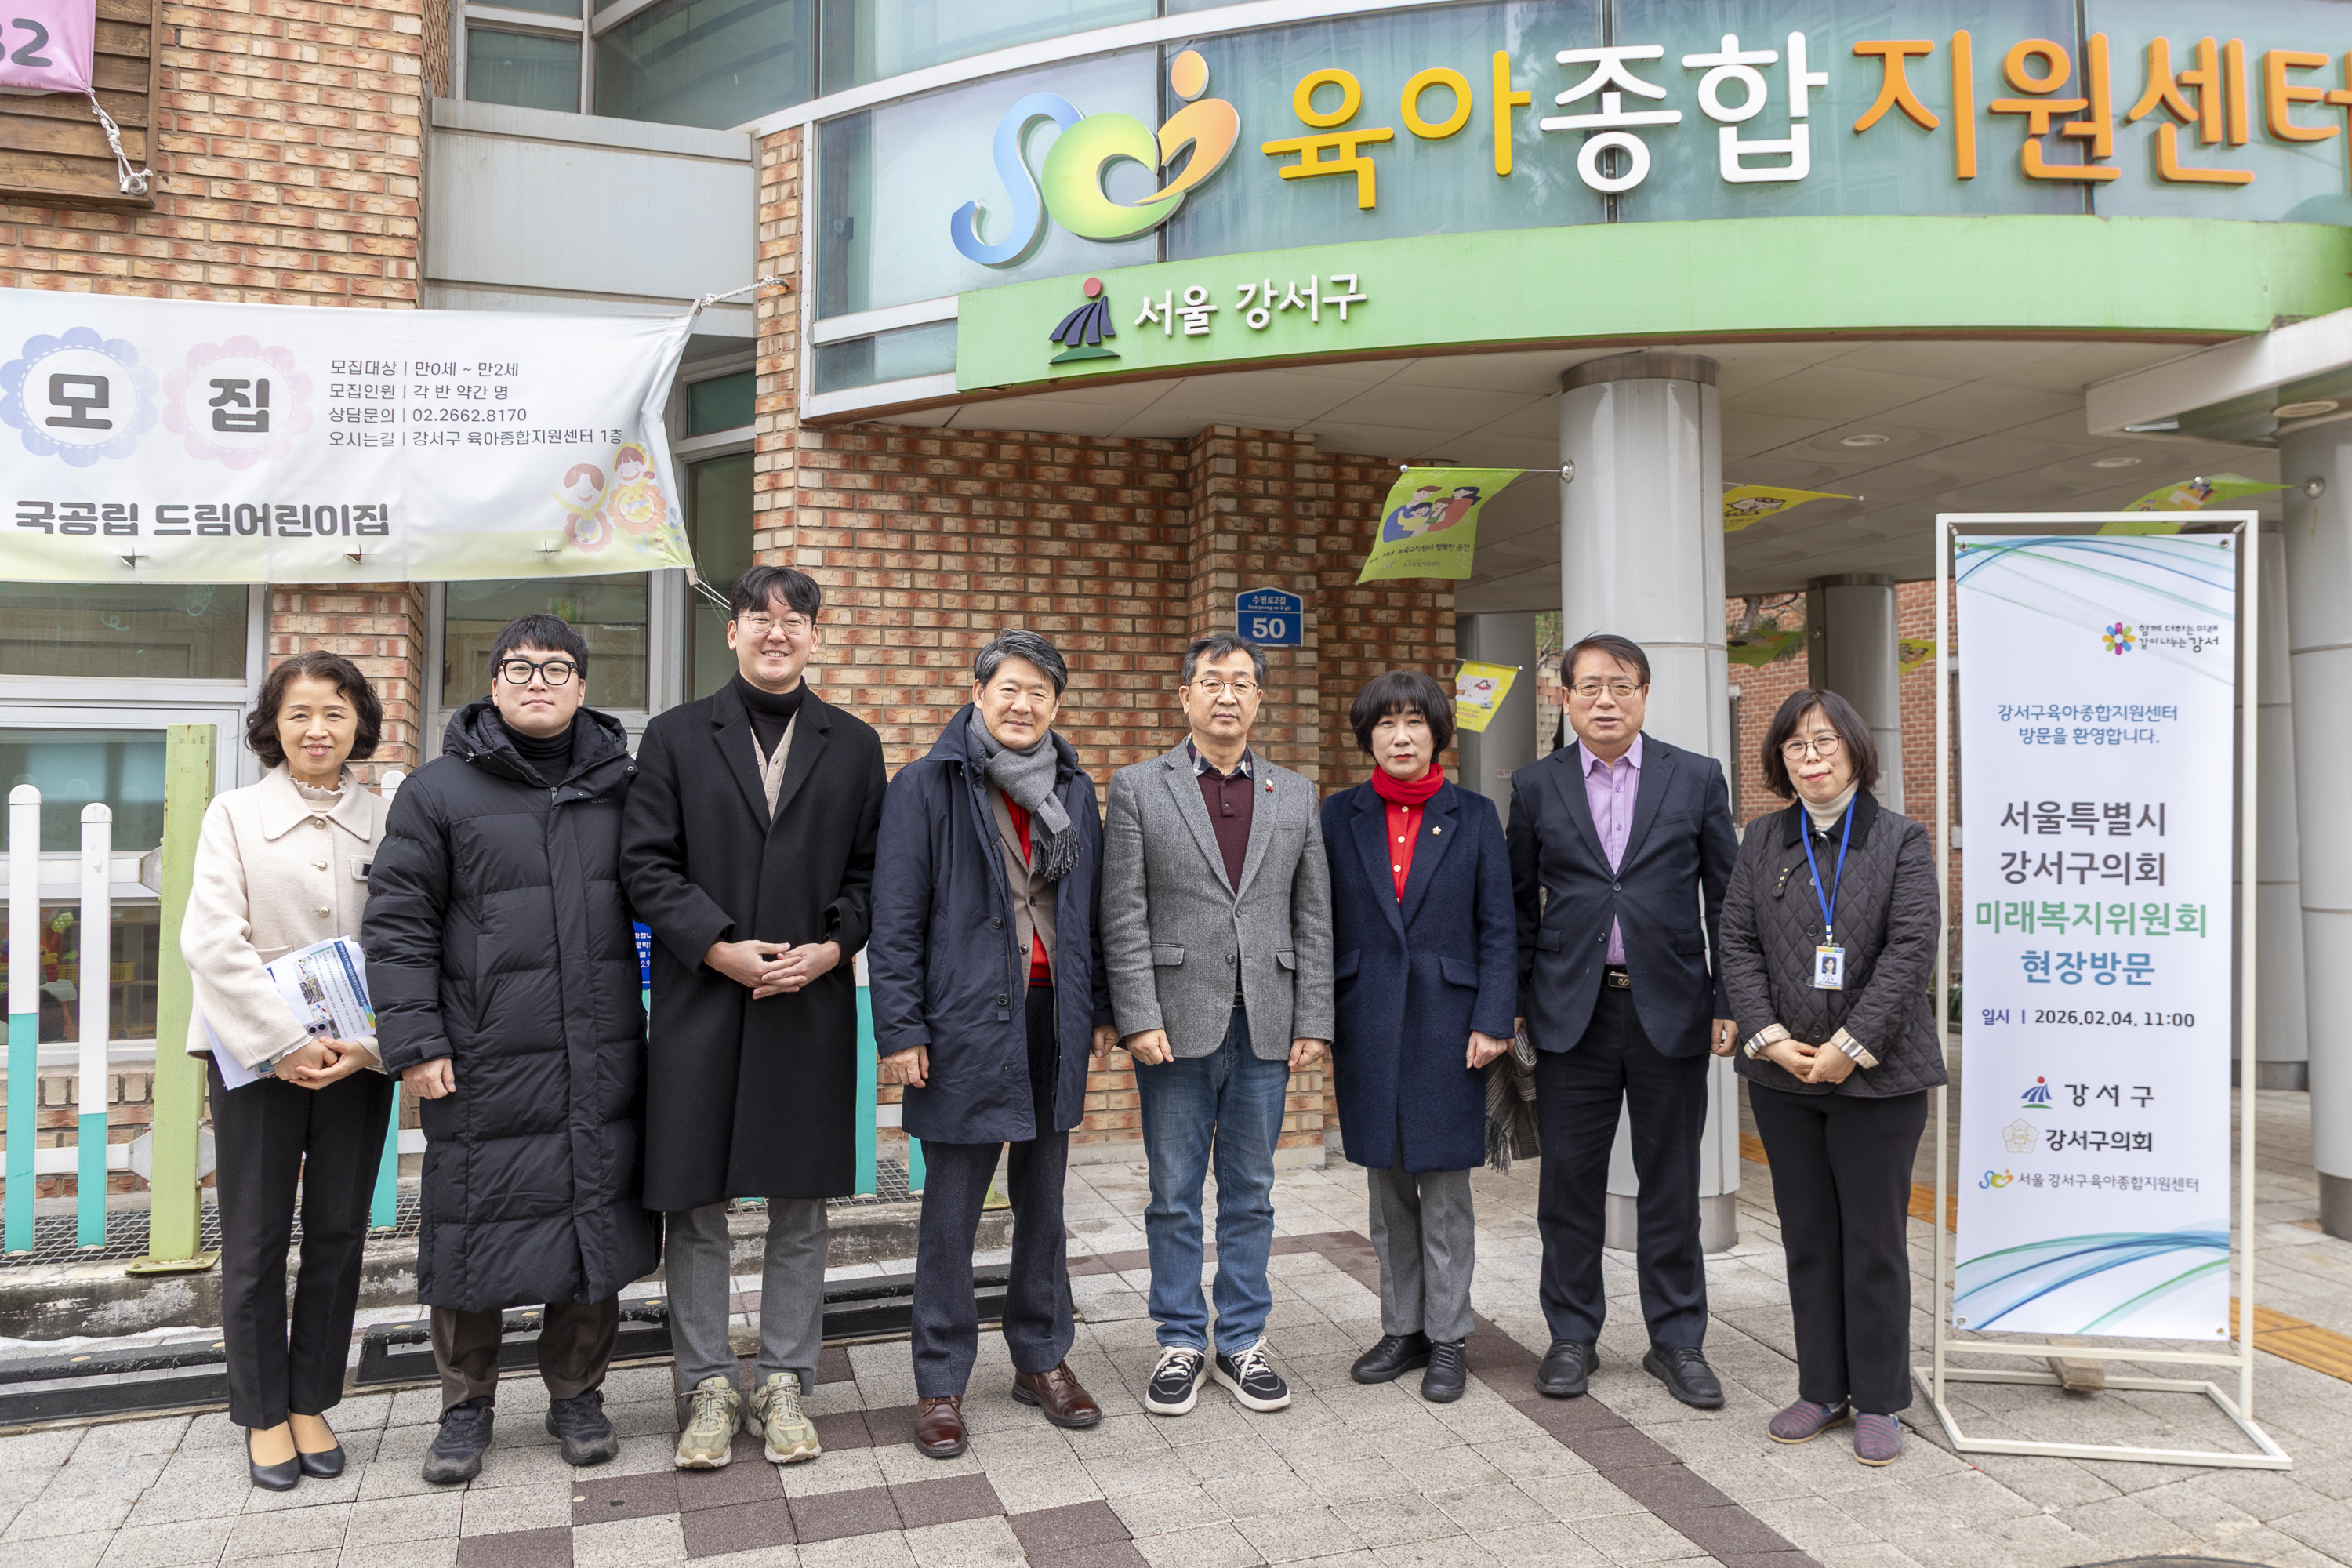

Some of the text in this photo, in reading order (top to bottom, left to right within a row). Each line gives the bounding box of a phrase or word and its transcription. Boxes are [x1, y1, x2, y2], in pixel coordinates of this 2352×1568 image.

[0, 18, 53, 67] 2
[1134, 273, 1367, 337] 서울 강서구
[330, 360, 397, 376] 모집대상
[415, 361, 456, 377] 만0세
[477, 362, 519, 377] 만2세
[329, 383, 509, 400] 모집인원 각 반 약간 명
[328, 407, 527, 423] 상담문의 02.2662.8170
[329, 428, 622, 447] 오시는길 강서구 육아종합지원센터 1층
[15, 500, 390, 538] 국공립 드림어린이집
[1252, 596, 1286, 605] 수명로2길
[1252, 617, 1286, 639] 50
[2139, 625, 2162, 637] 함께
[2189, 636, 2219, 653] 강서
[1998, 705, 2178, 722] 강서구육아종합지원센터
[2018, 728, 2160, 746] 방문을 환영합니다.
[2000, 800, 2166, 836] 서울특별시
[2000, 851, 2166, 886] 강서구의회
[1976, 900, 2207, 938] 미래복지위원회
[2020, 950, 2155, 985] 현장방문
[1982, 1008, 2195, 1028] 일시 2026.02.04. 11:00
[2045, 1129, 2153, 1152] 강서구의회
[2018, 1173, 2199, 1192] 서울 강서구육아종합지원센터
